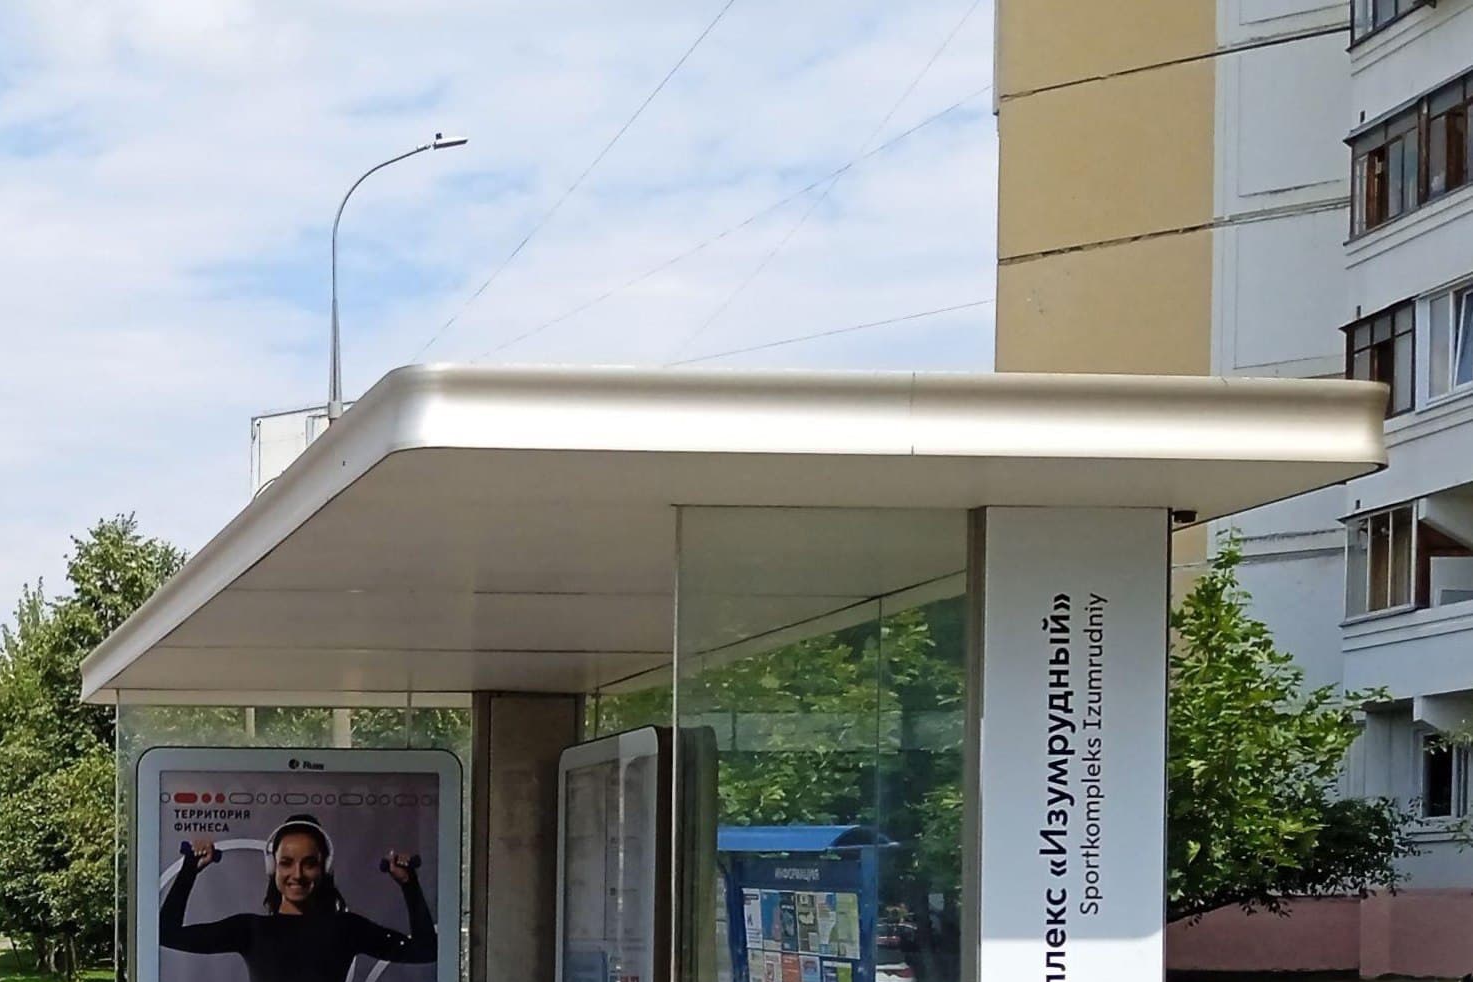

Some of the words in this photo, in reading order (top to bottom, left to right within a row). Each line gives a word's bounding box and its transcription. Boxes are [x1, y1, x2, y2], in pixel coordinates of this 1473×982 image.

[1082, 593, 1108, 730] Izumrudniy
[1038, 593, 1076, 877] «Изумрудный»
[174, 808, 251, 820] ТЕРРИТОРИЯ
[174, 822, 230, 833] ФИТНЕСА
[1079, 738, 1105, 915] Sportkompleks
